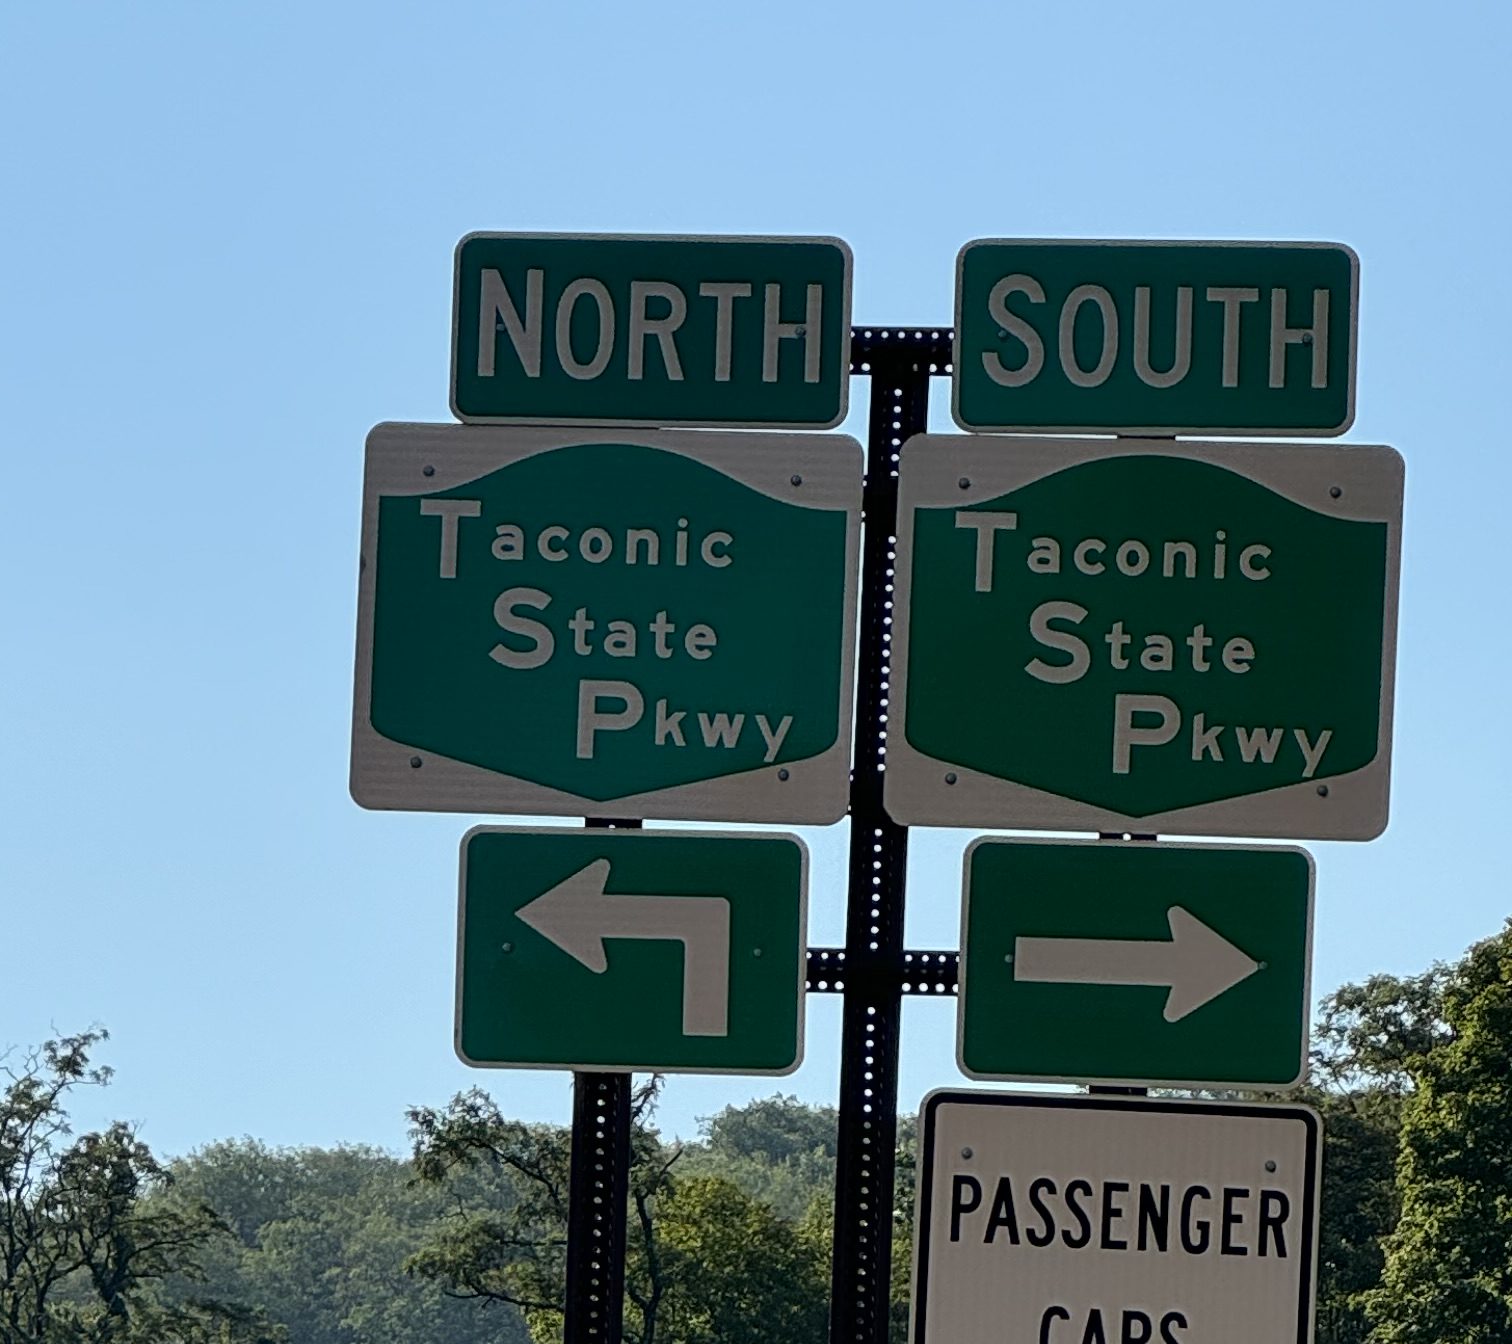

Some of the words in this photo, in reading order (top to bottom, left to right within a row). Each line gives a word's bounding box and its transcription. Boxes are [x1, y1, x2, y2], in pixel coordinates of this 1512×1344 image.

[476, 268, 821, 384] NORTH
[981, 273, 1330, 390] SOUTH
[419, 498, 735, 579] Taconic
[954, 510, 1273, 593] Taconic
[487, 586, 718, 670] State
[1023, 600, 1257, 686] State
[575, 678, 794, 764] Pkwy
[1111, 692, 1333, 778] Pkwy
[949, 1174, 1290, 1260] PASSENGER
